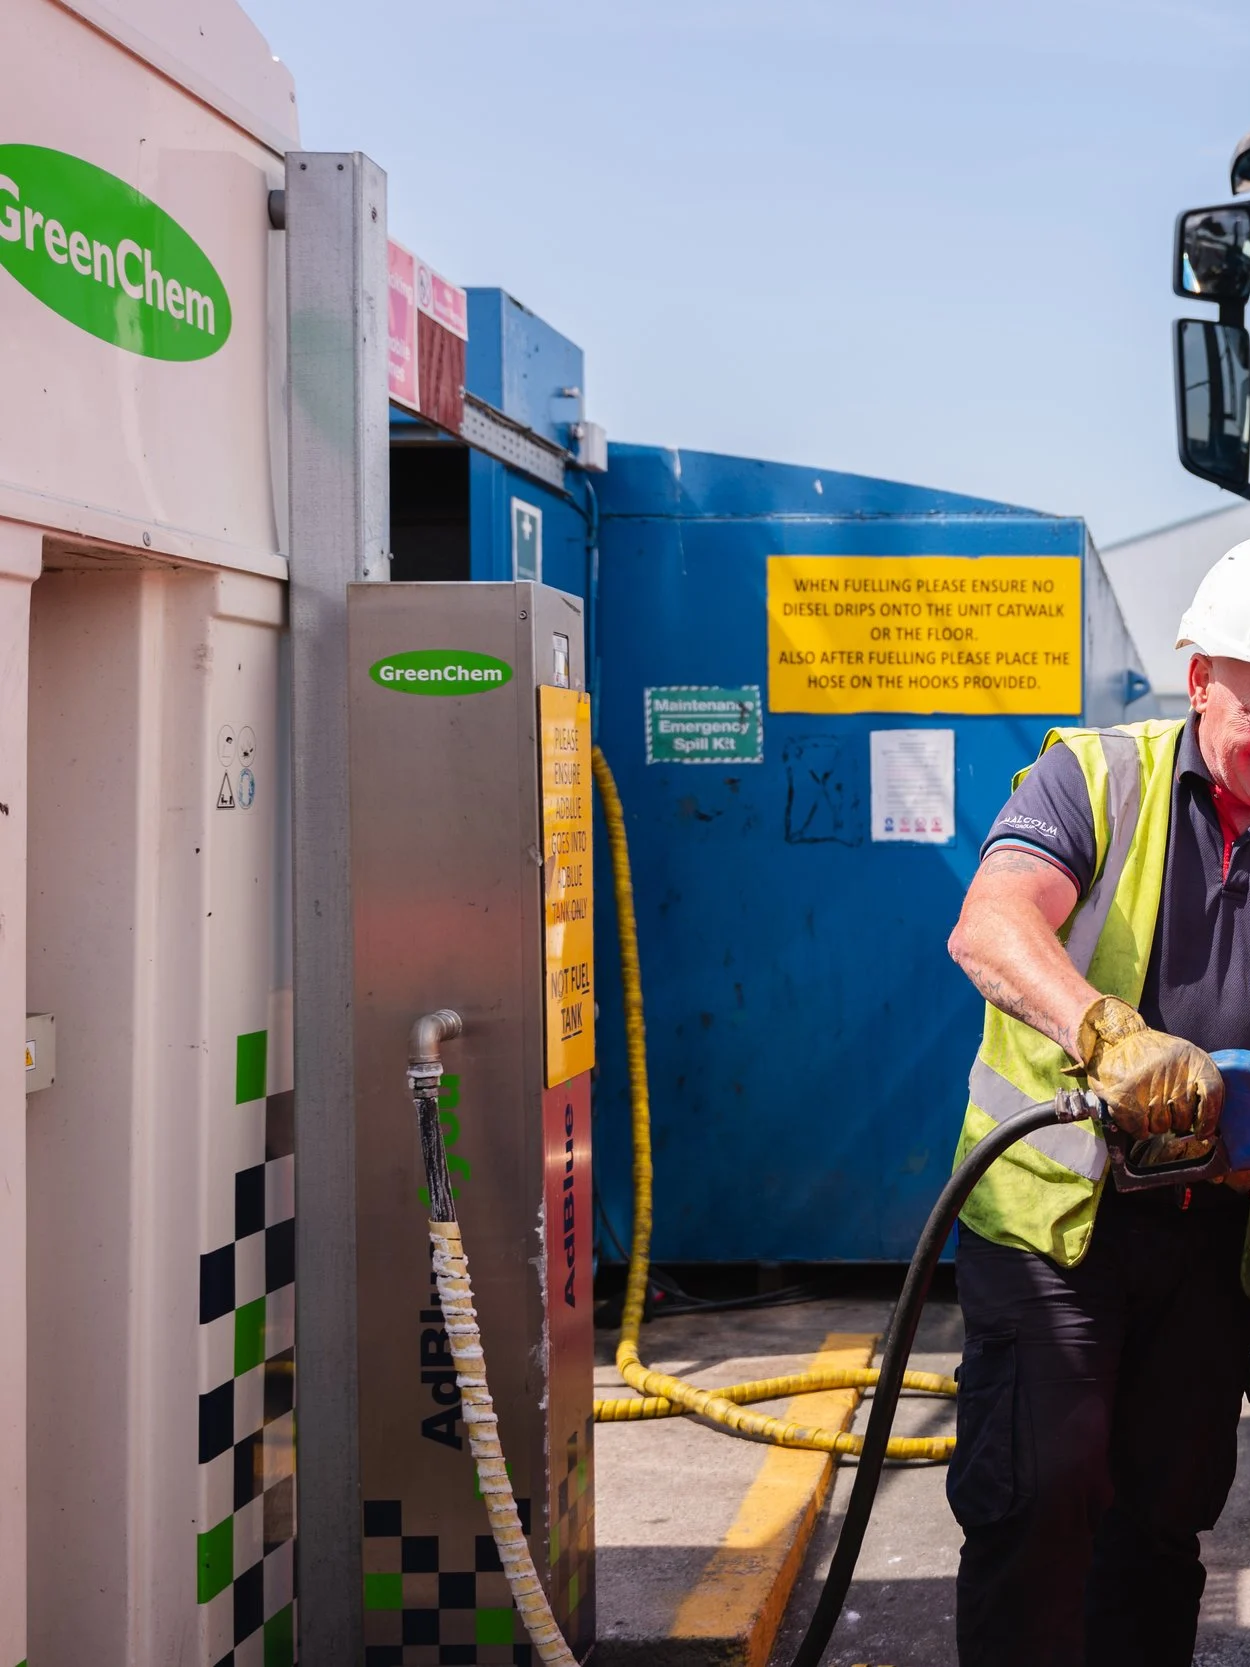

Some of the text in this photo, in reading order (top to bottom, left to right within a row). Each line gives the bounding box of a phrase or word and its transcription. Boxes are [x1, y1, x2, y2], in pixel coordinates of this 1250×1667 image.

[0, 174, 215, 335] GreenChem
[794, 578, 1055, 593] WHEN FUELLING PLEASE ENSURE NO
[783, 602, 1064, 617] DIESEL DRIPS ONTO THE UNIT CATWALK
[870, 626, 978, 641] OR THE FLOOR.
[779, 651, 1070, 665] ALSO AFTER FUELLING PLEASE PLACE THE
[379, 665, 503, 681] GreenChem
[807, 674, 1041, 689] HOSE ON THE HOOKS PROVIDED.
[659, 719, 750, 735] Emergency
[554, 727, 579, 751] PLEASE
[673, 737, 709, 753] Spill
[554, 761, 581, 785] ENSURE
[555, 797, 582, 819] ADBLUE
[1004, 814, 1058, 836] MALCOLM
[552, 830, 587, 856] GOES INTO
[557, 864, 582, 888] ADBLUE
[551, 897, 587, 924] TANK ONLY
[551, 962, 590, 999] NOT FUEL
[561, 1002, 582, 1034] TANK
[563, 1102, 575, 1309] AdBlue
[420, 1240, 464, 1452] AdBl
